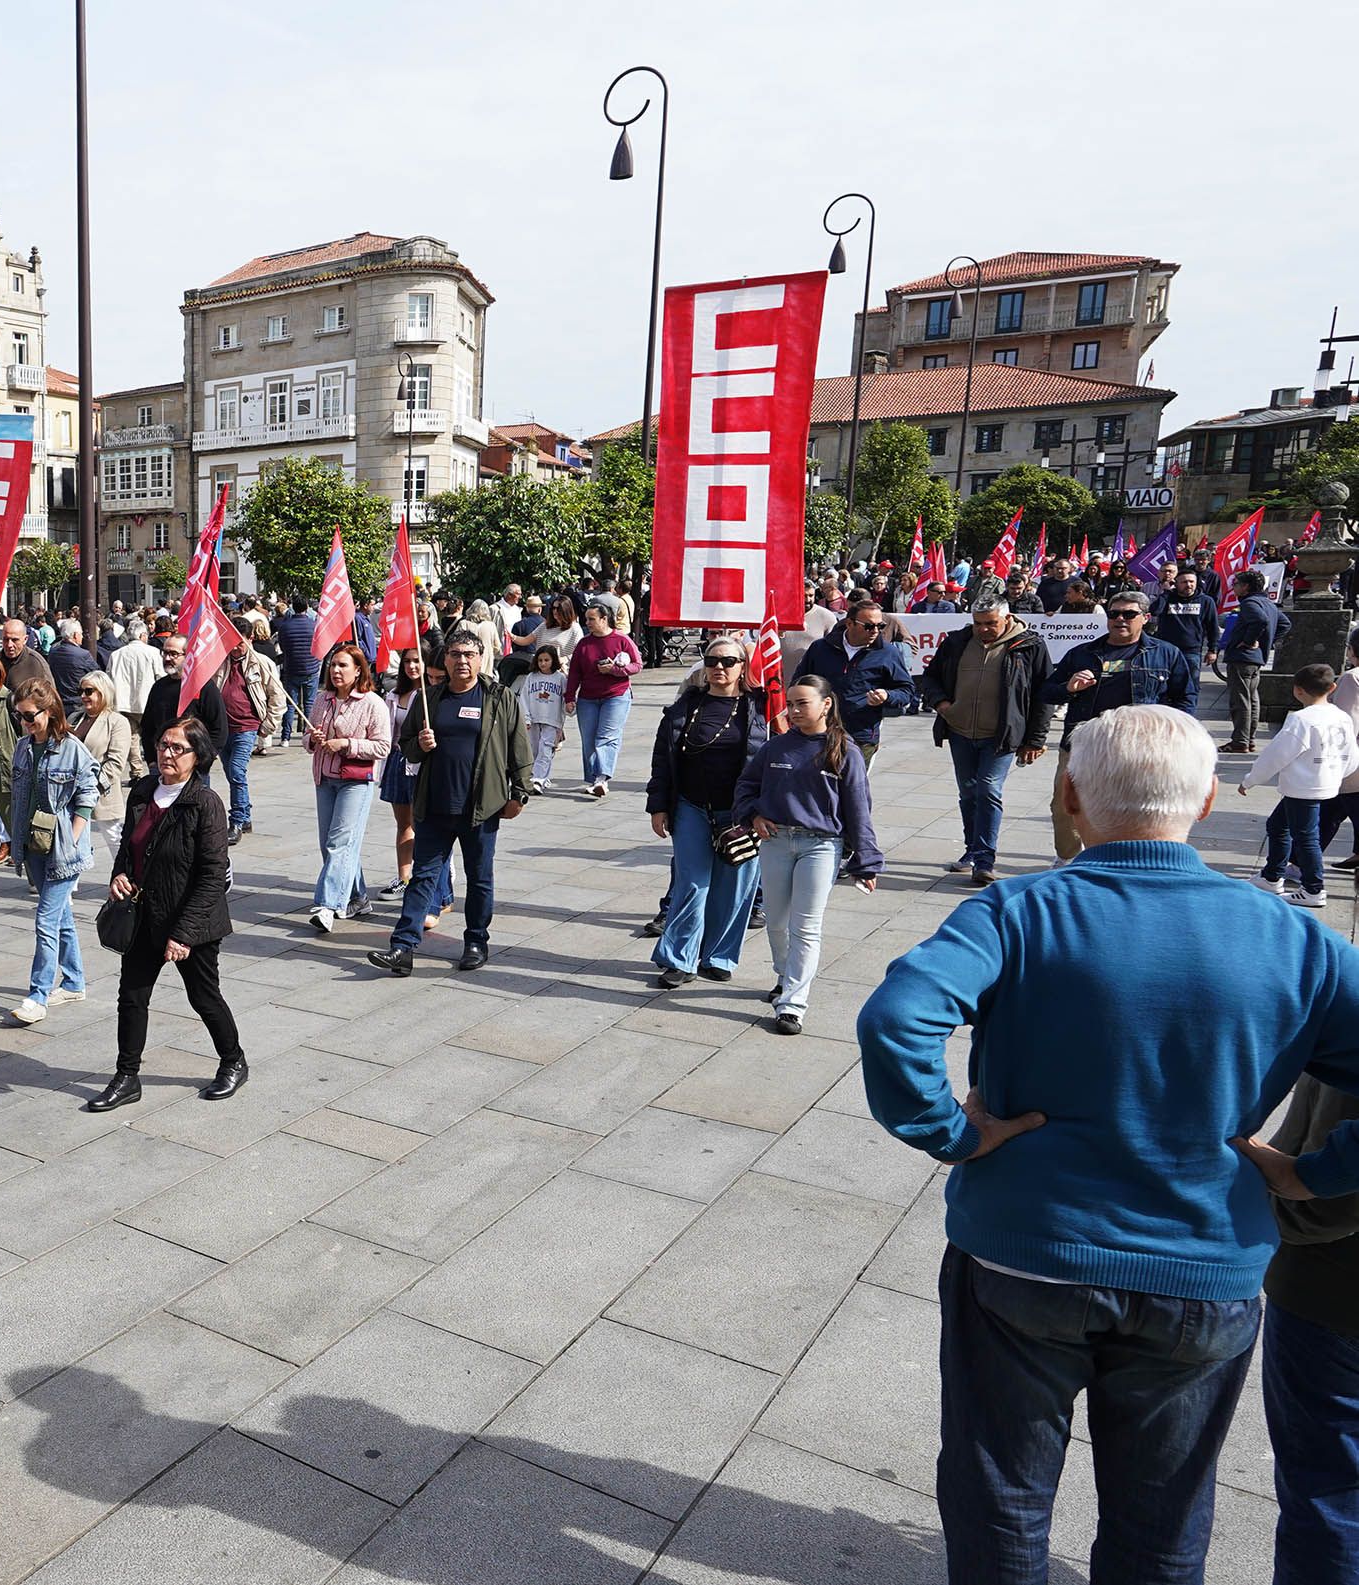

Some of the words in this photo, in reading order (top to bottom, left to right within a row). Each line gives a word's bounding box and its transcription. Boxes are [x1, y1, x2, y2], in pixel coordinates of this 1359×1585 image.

[680, 283, 786, 621] CCOO
[1123, 488, 1173, 506] MAIO
[1040, 622, 1083, 631] Empresa
[1086, 622, 1099, 630] do
[1047, 632, 1096, 641] Sanxenxo
